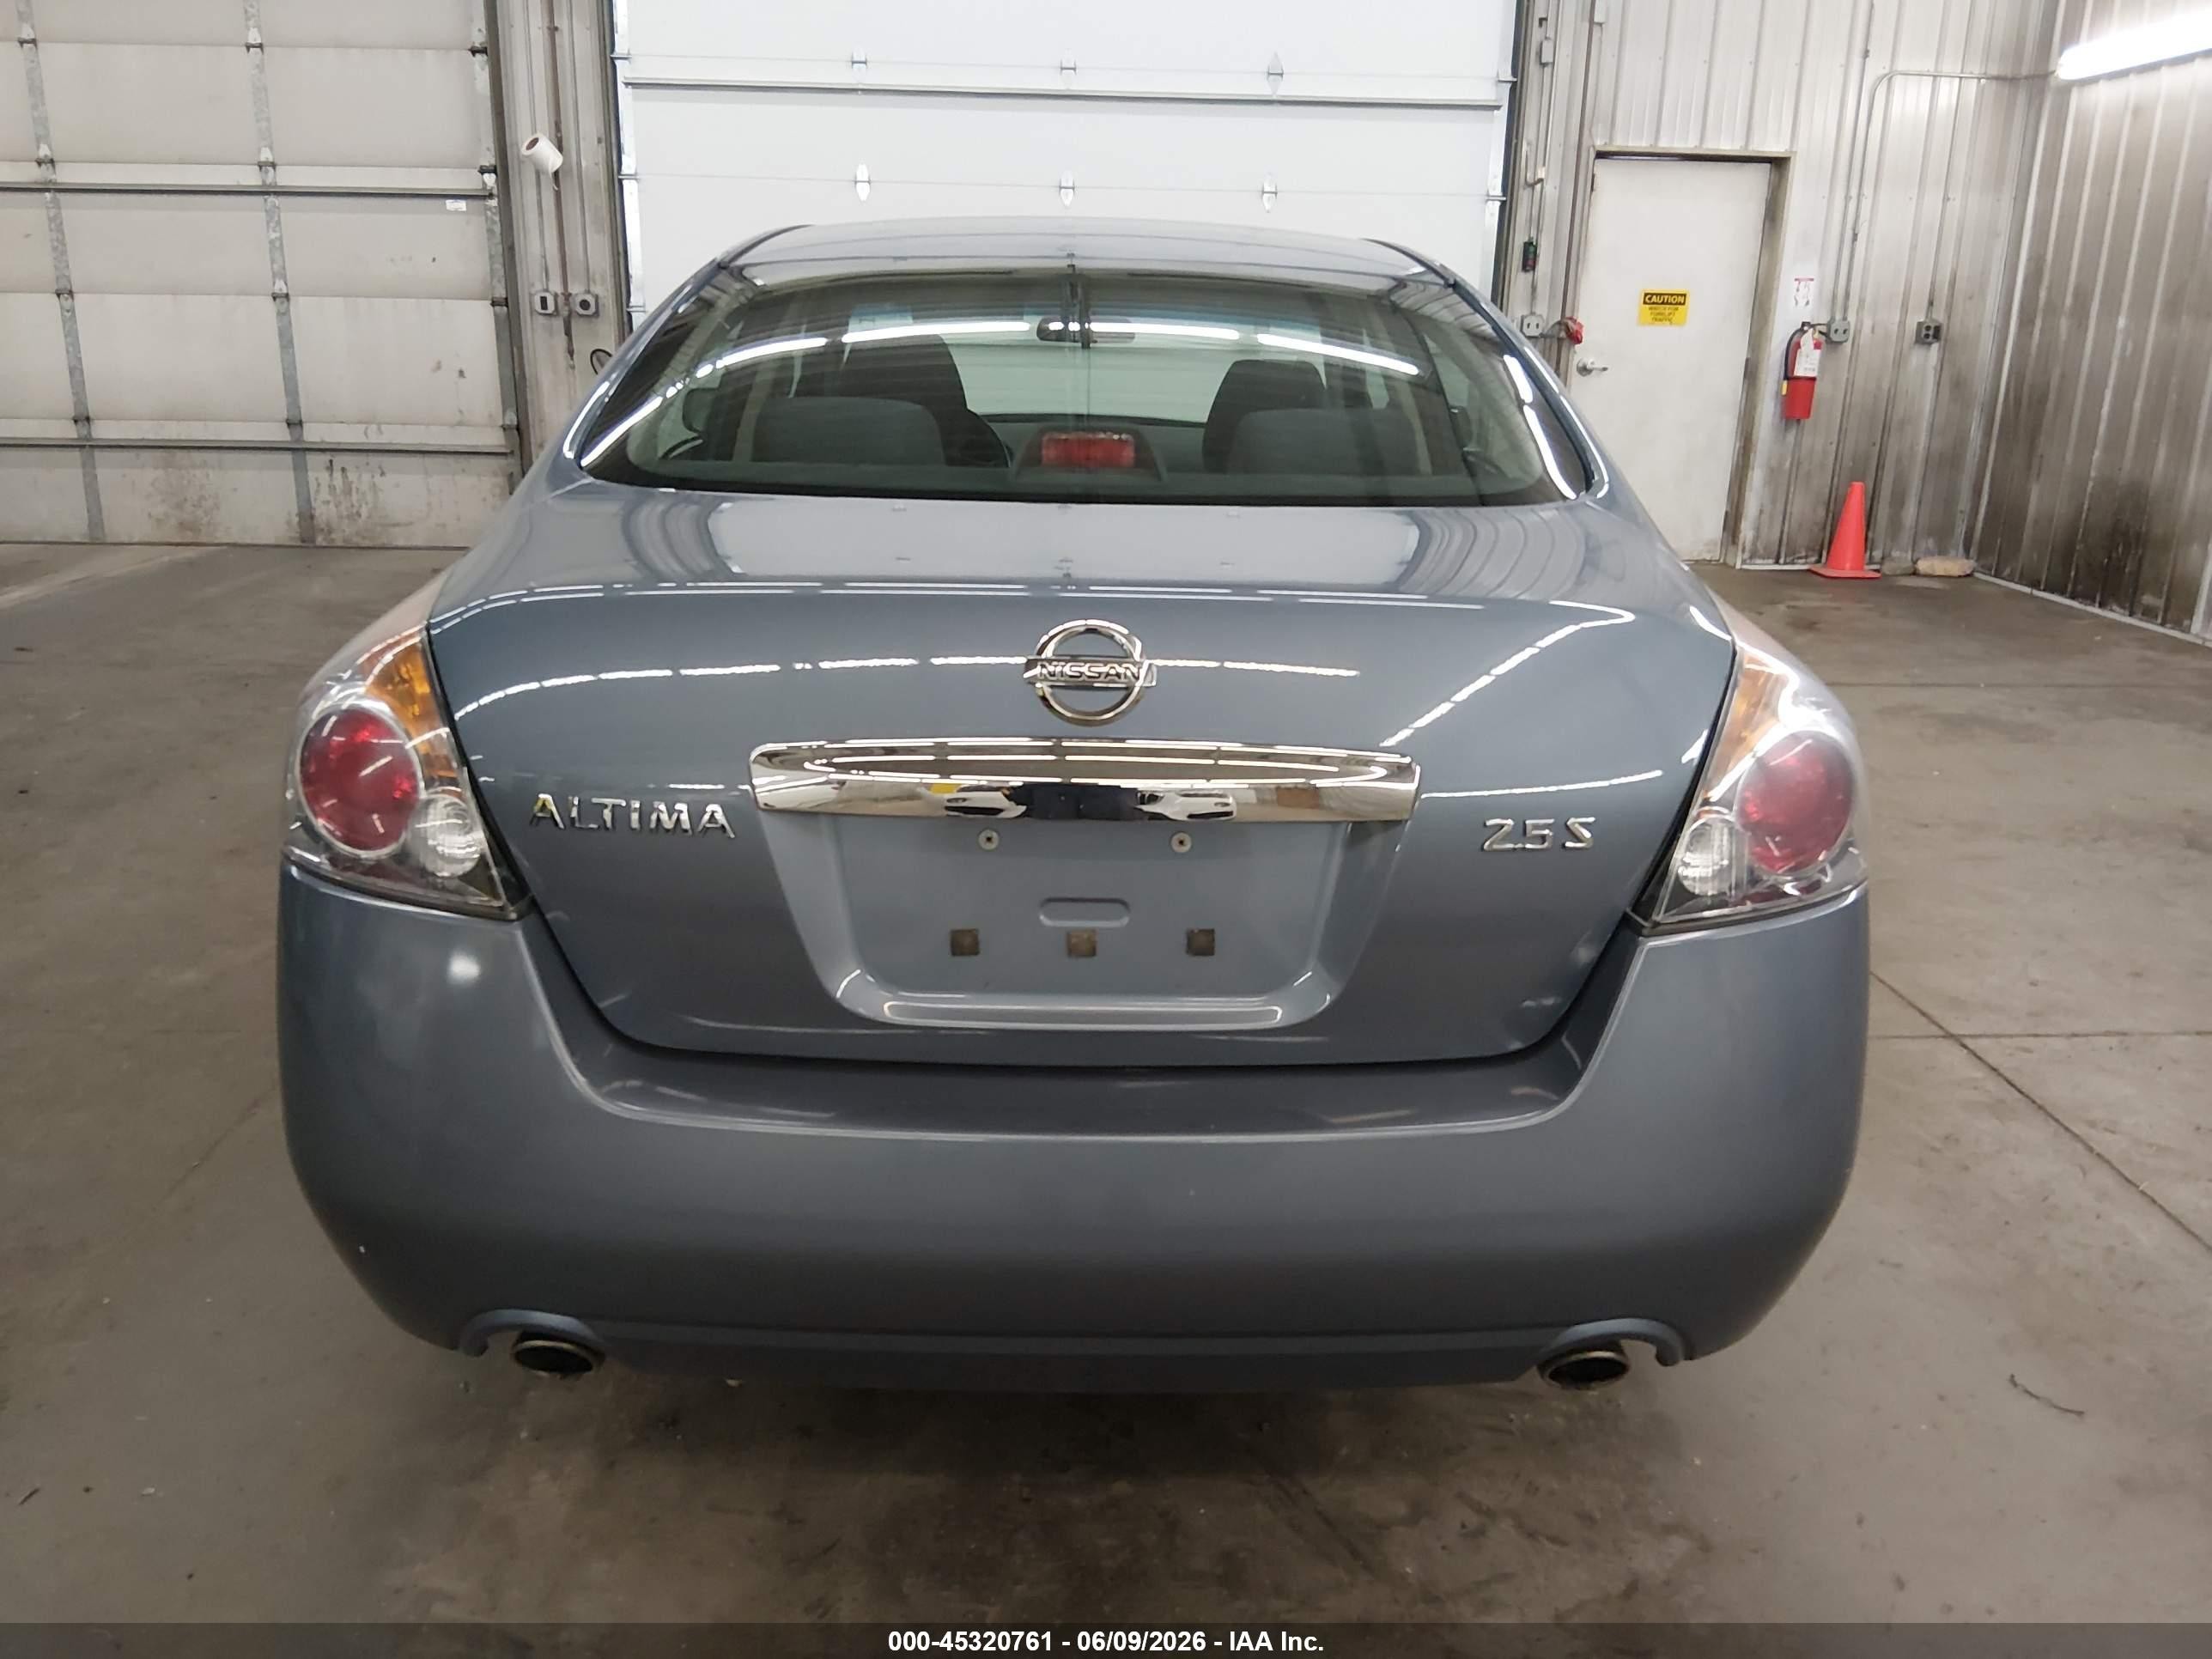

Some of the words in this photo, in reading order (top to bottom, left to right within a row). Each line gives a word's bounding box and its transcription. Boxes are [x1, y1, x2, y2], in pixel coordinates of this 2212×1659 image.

[1645, 295, 1685, 303] CAUTION
[1037, 661, 1141, 681] NISSAN
[530, 793, 736, 839] ALTIMA
[1562, 817, 1596, 849] S
